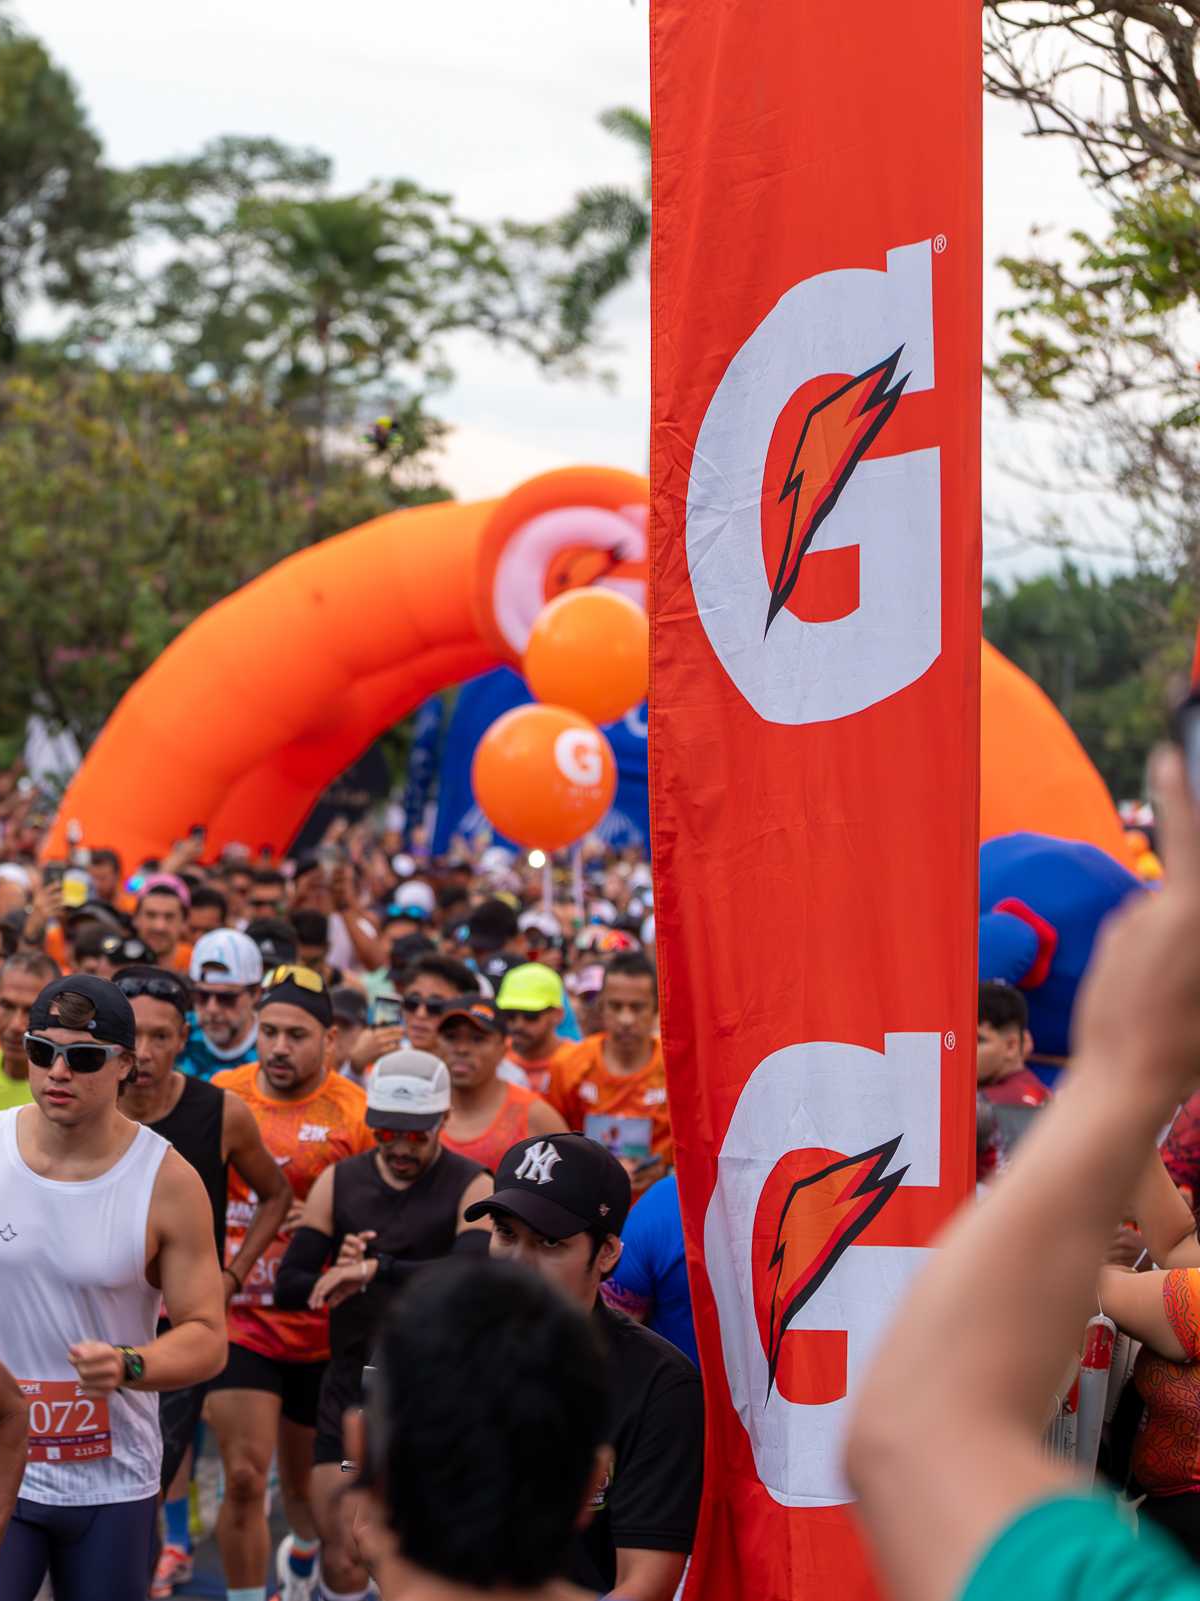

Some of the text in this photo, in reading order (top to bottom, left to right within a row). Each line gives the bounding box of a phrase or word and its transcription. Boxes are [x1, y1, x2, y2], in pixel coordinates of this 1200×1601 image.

[686, 237, 943, 725] G
[555, 729, 602, 785] G
[298, 1123, 330, 1142] 21K
[514, 1141, 562, 1184] NY
[29, 1400, 99, 1434] 072
